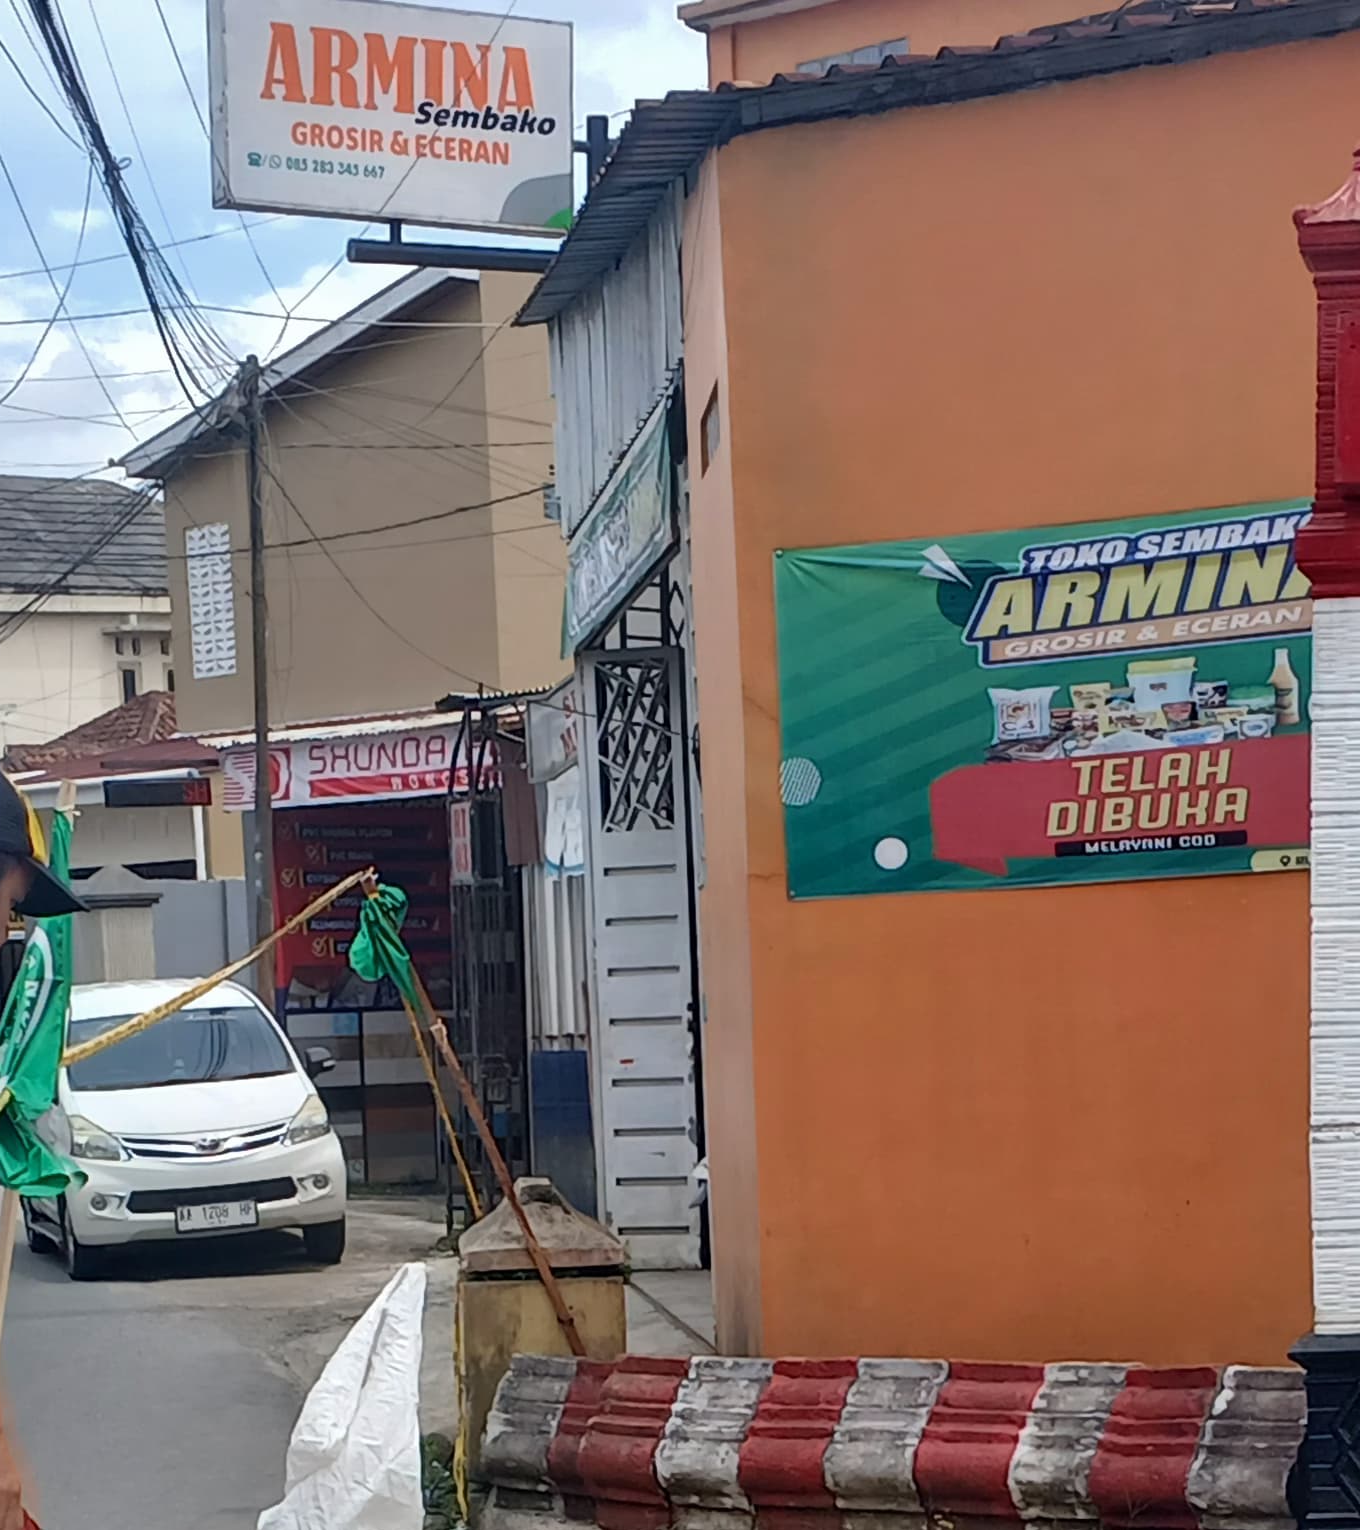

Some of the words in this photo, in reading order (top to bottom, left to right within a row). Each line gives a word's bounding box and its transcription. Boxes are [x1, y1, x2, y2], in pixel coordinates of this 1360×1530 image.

[259, 21, 537, 114] ARMINA
[414, 100, 557, 137] Sembako
[290, 120, 385, 154] GROSIR
[390, 130, 409, 157] &
[414, 133, 511, 165] ECERAN
[1028, 540, 1128, 574] TOKO
[1002, 627, 1128, 659] GROSIR
[1135, 623, 1159, 642] &
[1172, 605, 1304, 639] ECERAN
[307, 734, 448, 776] SHUNDA
[1071, 748, 1232, 796] TELAH
[1046, 787, 1249, 837] DIBUKA
[1085, 836, 1173, 854] MELAYANI
[1179, 833, 1216, 848] COD
